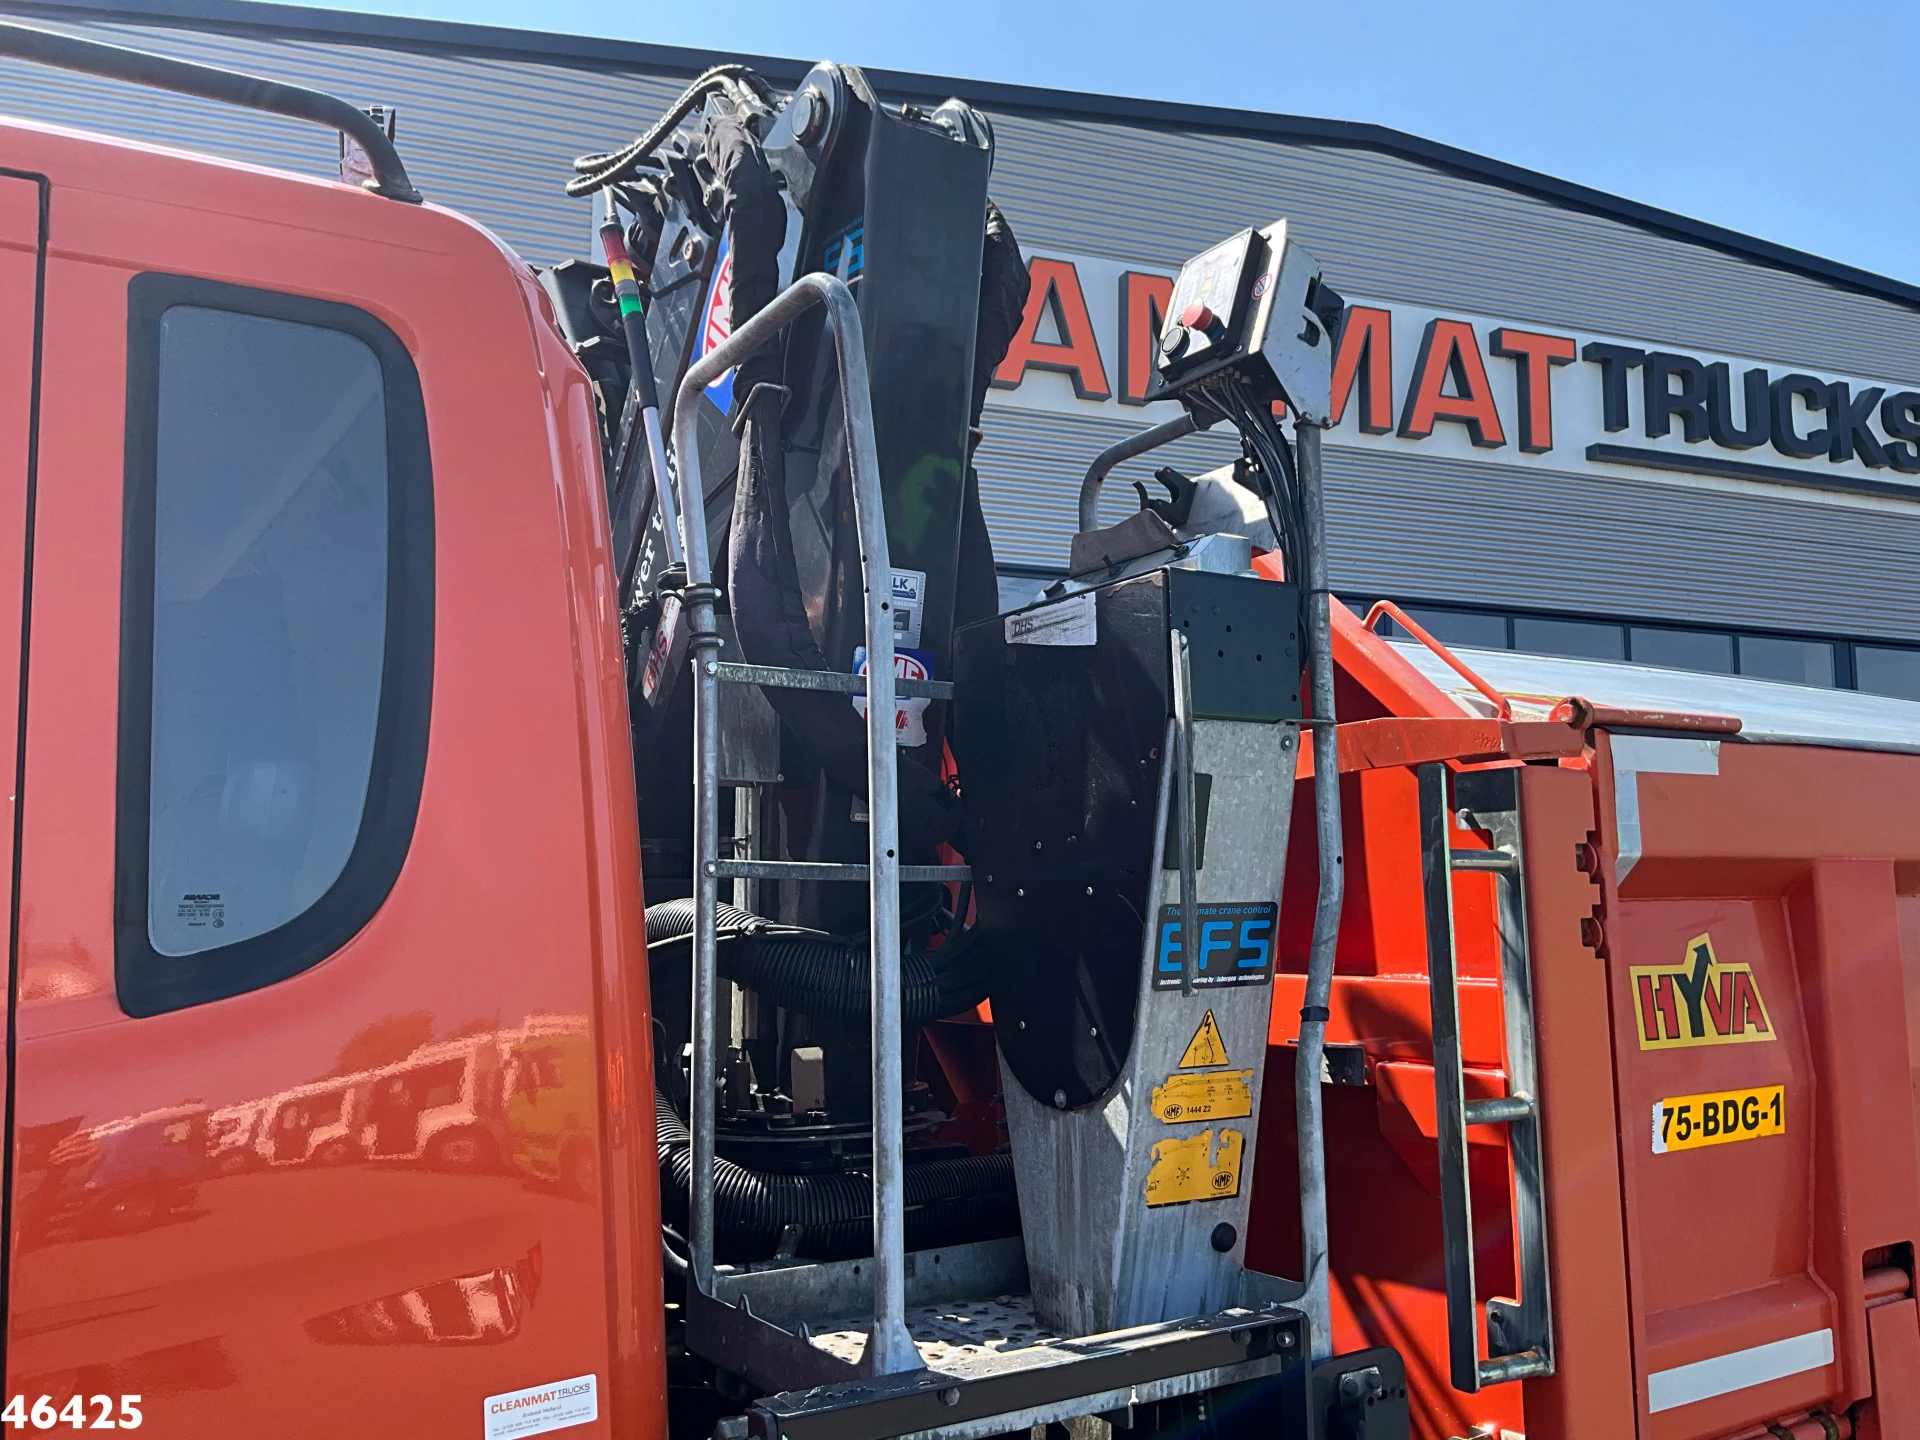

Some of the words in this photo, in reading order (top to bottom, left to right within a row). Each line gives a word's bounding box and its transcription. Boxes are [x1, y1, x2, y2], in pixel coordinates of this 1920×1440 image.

[1582, 341, 1920, 474] TRUCKS
[892, 577, 908, 590] LK
[1014, 619, 1033, 634] DHS
[647, 631, 668, 692] DHS
[1167, 906, 1181, 916] The
[1196, 906, 1217, 915] mate
[1218, 907, 1241, 915] crane
[1243, 905, 1271, 914] control
[1158, 919, 1271, 972] EFS
[1637, 943, 1769, 1041] HYVA
[1166, 1106, 1180, 1117] HMF
[1187, 1105, 1201, 1113] 1444
[1662, 1092, 1781, 1143] 75-BDG-1
[1215, 1174, 1231, 1187] HMF
[491, 1391, 556, 1414] CLEANMAT
[558, 1383, 590, 1397] TRUCKS
